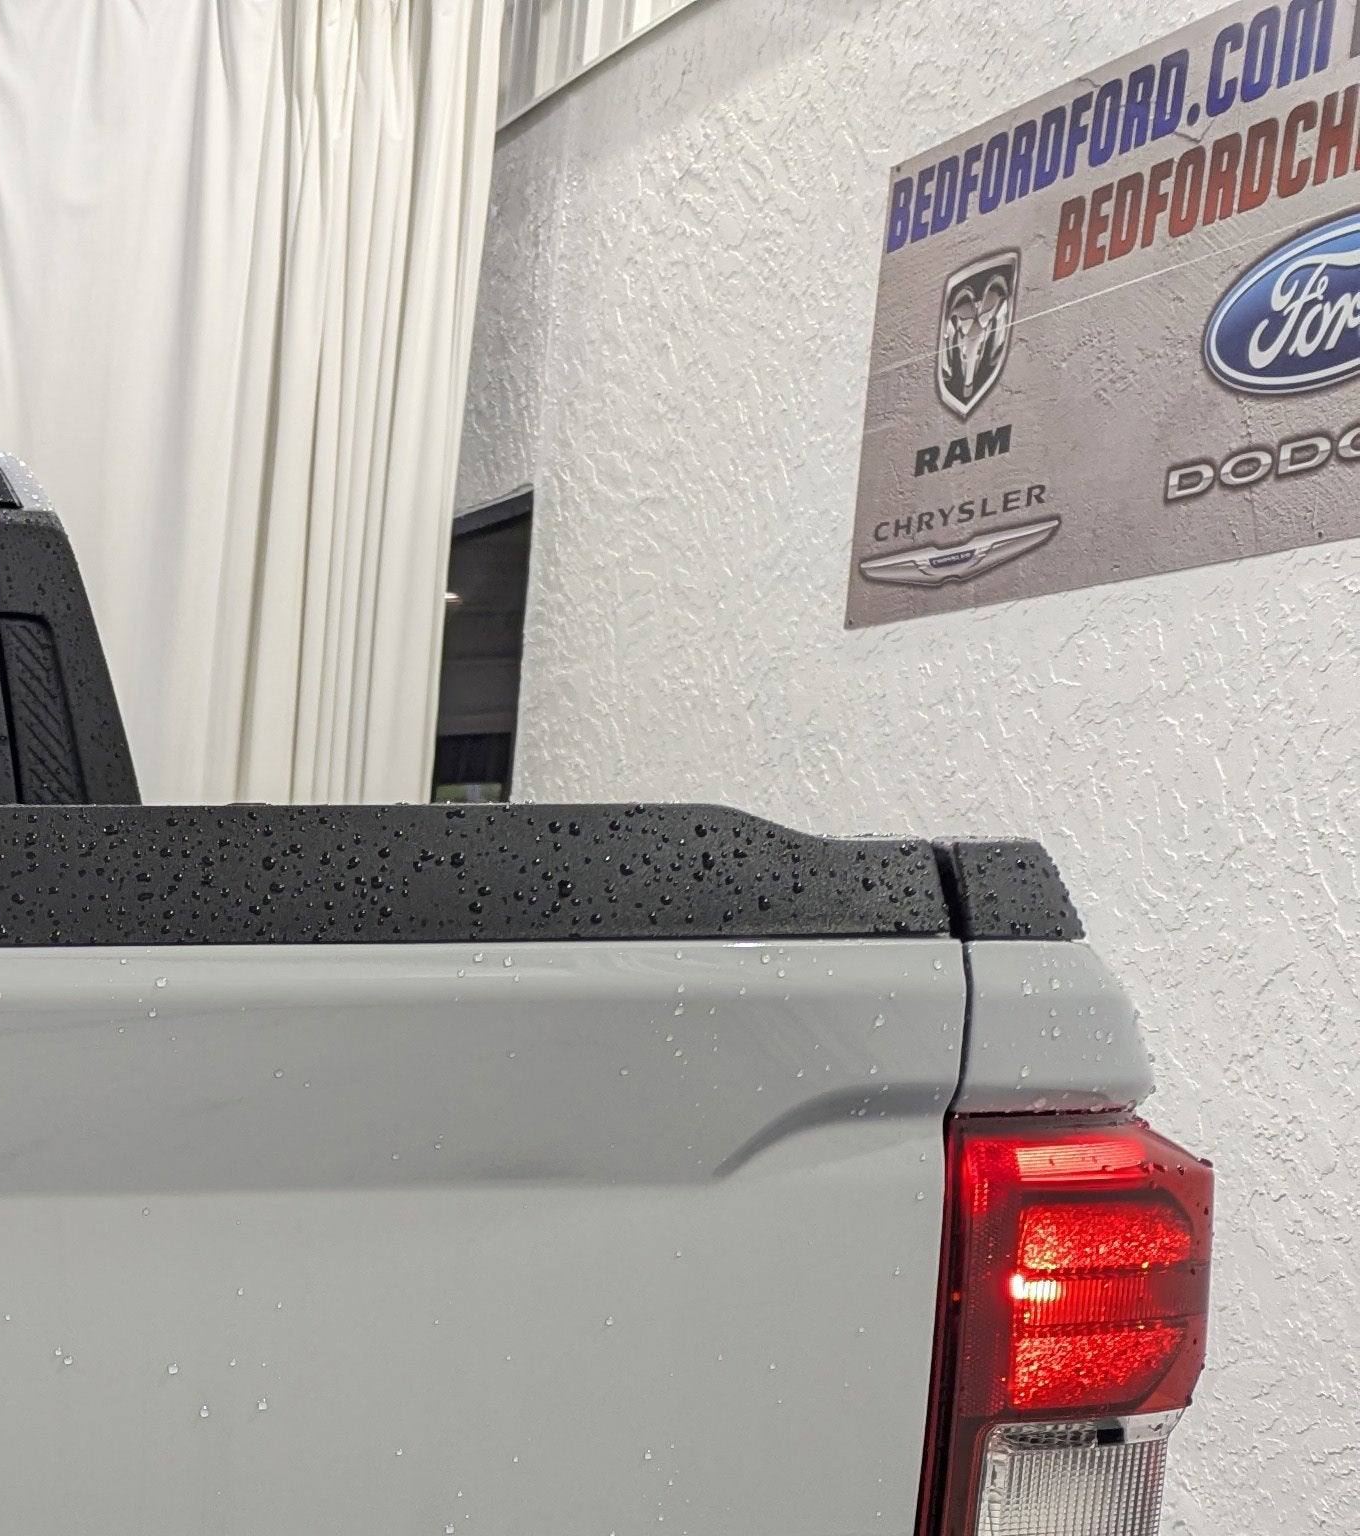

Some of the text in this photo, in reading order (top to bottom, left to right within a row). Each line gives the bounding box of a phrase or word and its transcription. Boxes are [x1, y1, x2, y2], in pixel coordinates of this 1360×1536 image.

[887, 0, 1336, 253] BEDFORDFORD.COM
[1053, 83, 1360, 281] BEDFORDCH
[1248, 249, 1360, 369] For
[914, 424, 1012, 477] RAM
[874, 484, 1047, 541] CHRYSLER
